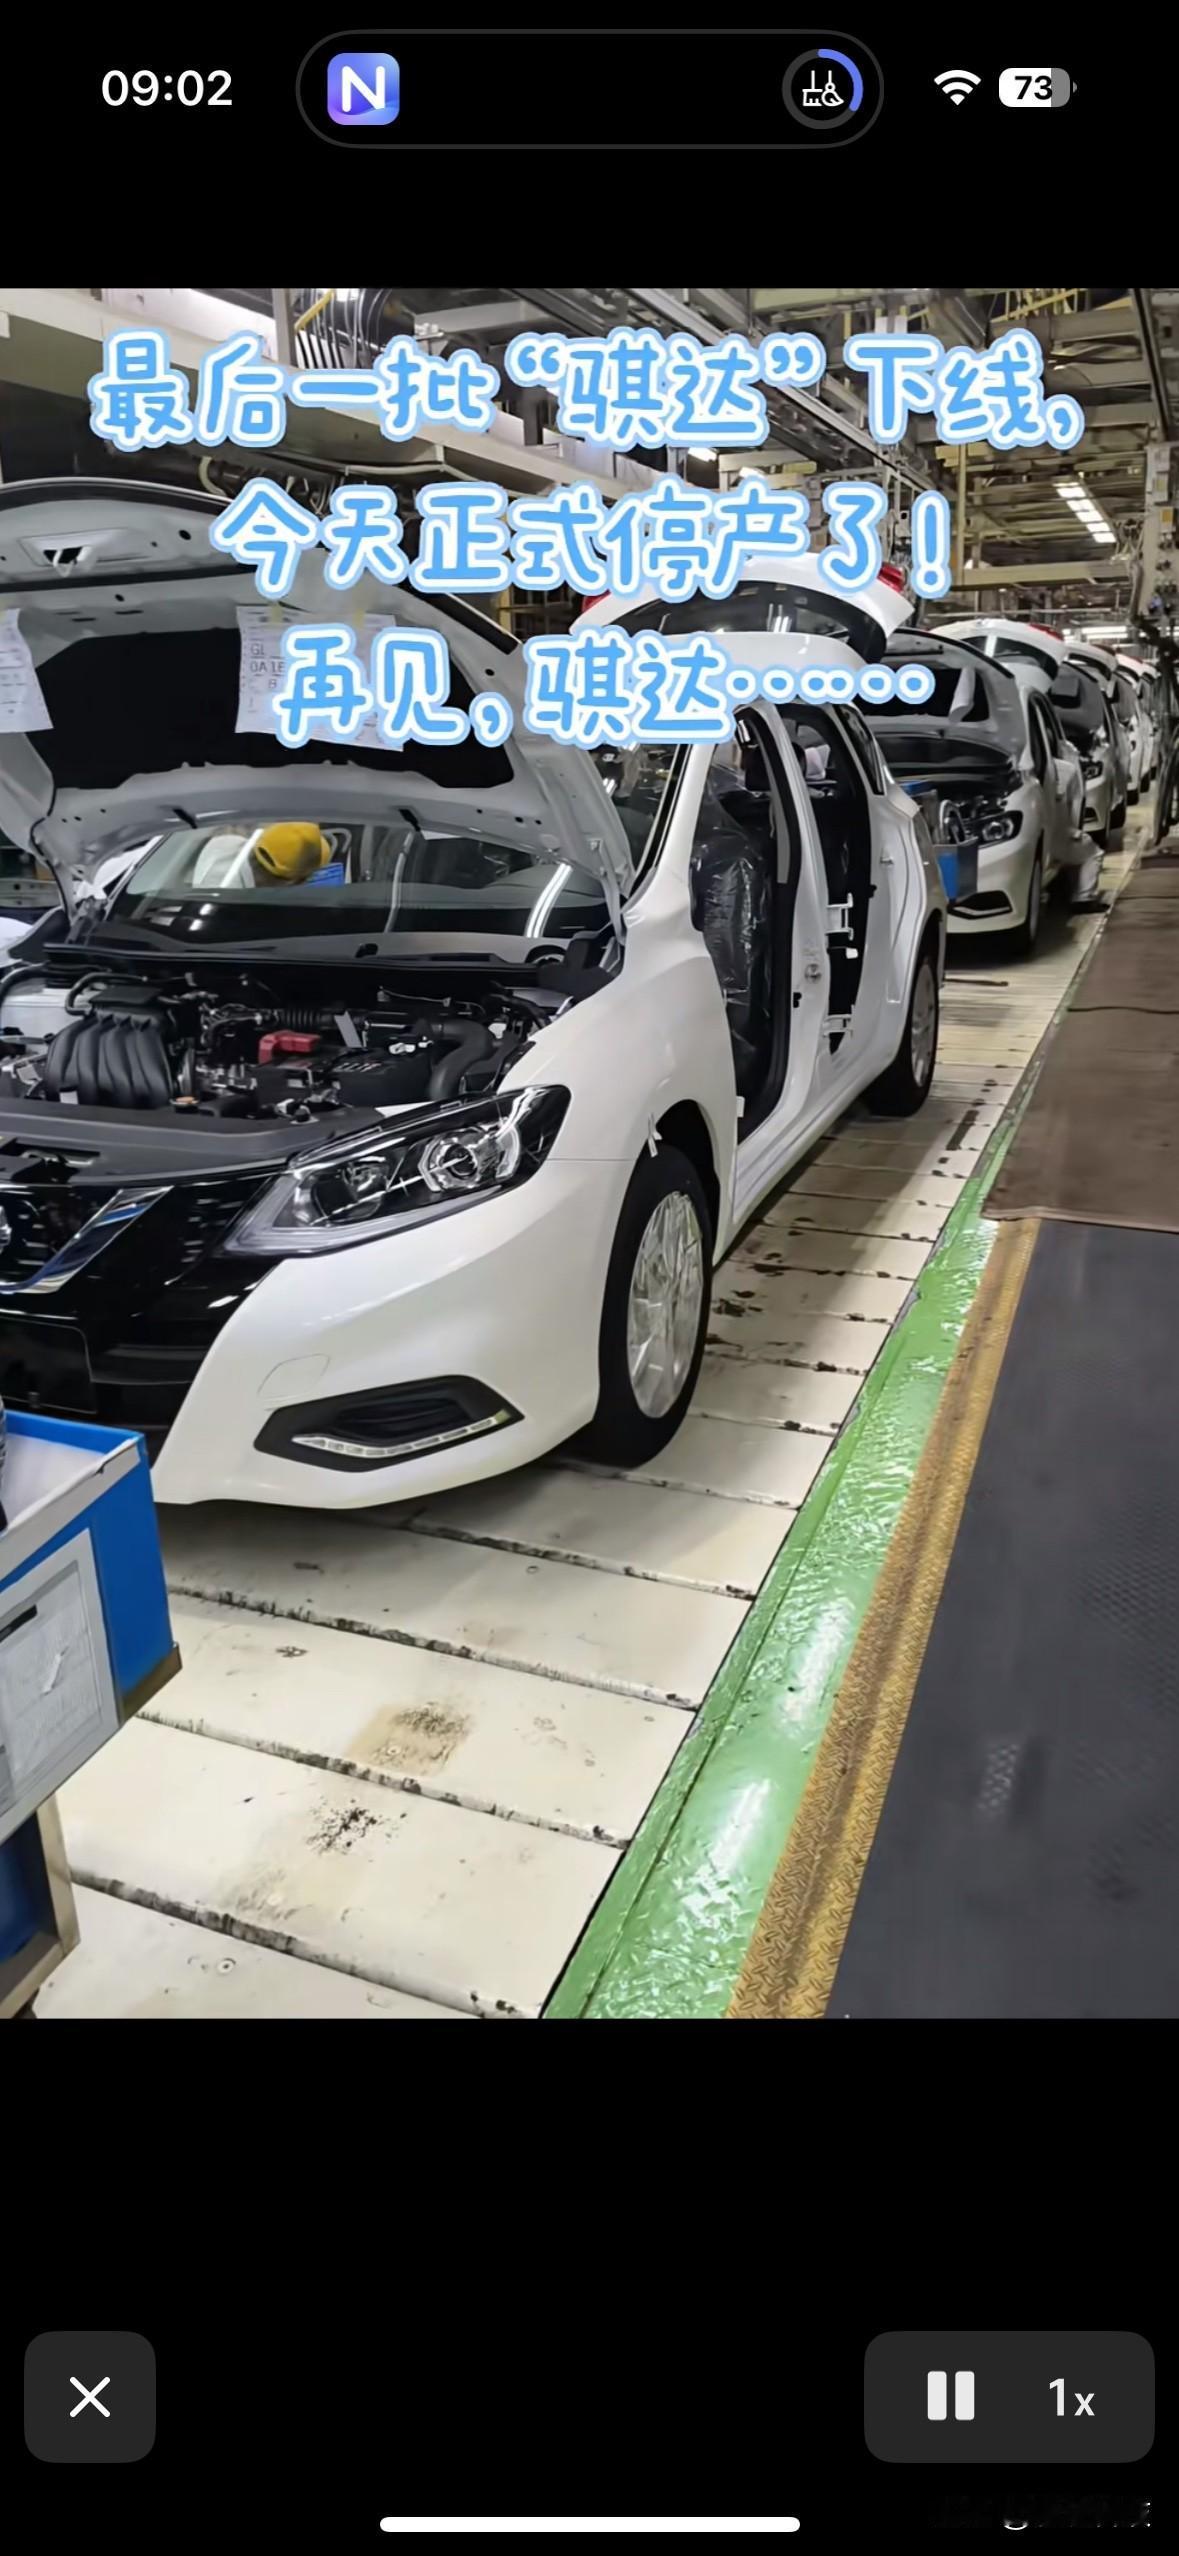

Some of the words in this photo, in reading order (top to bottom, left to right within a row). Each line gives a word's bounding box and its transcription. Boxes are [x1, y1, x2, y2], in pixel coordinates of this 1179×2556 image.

[101, 69, 233, 108] 09:02
[1013, 75, 1053, 102] 73
[1048, 2377, 1096, 2418] 1x
